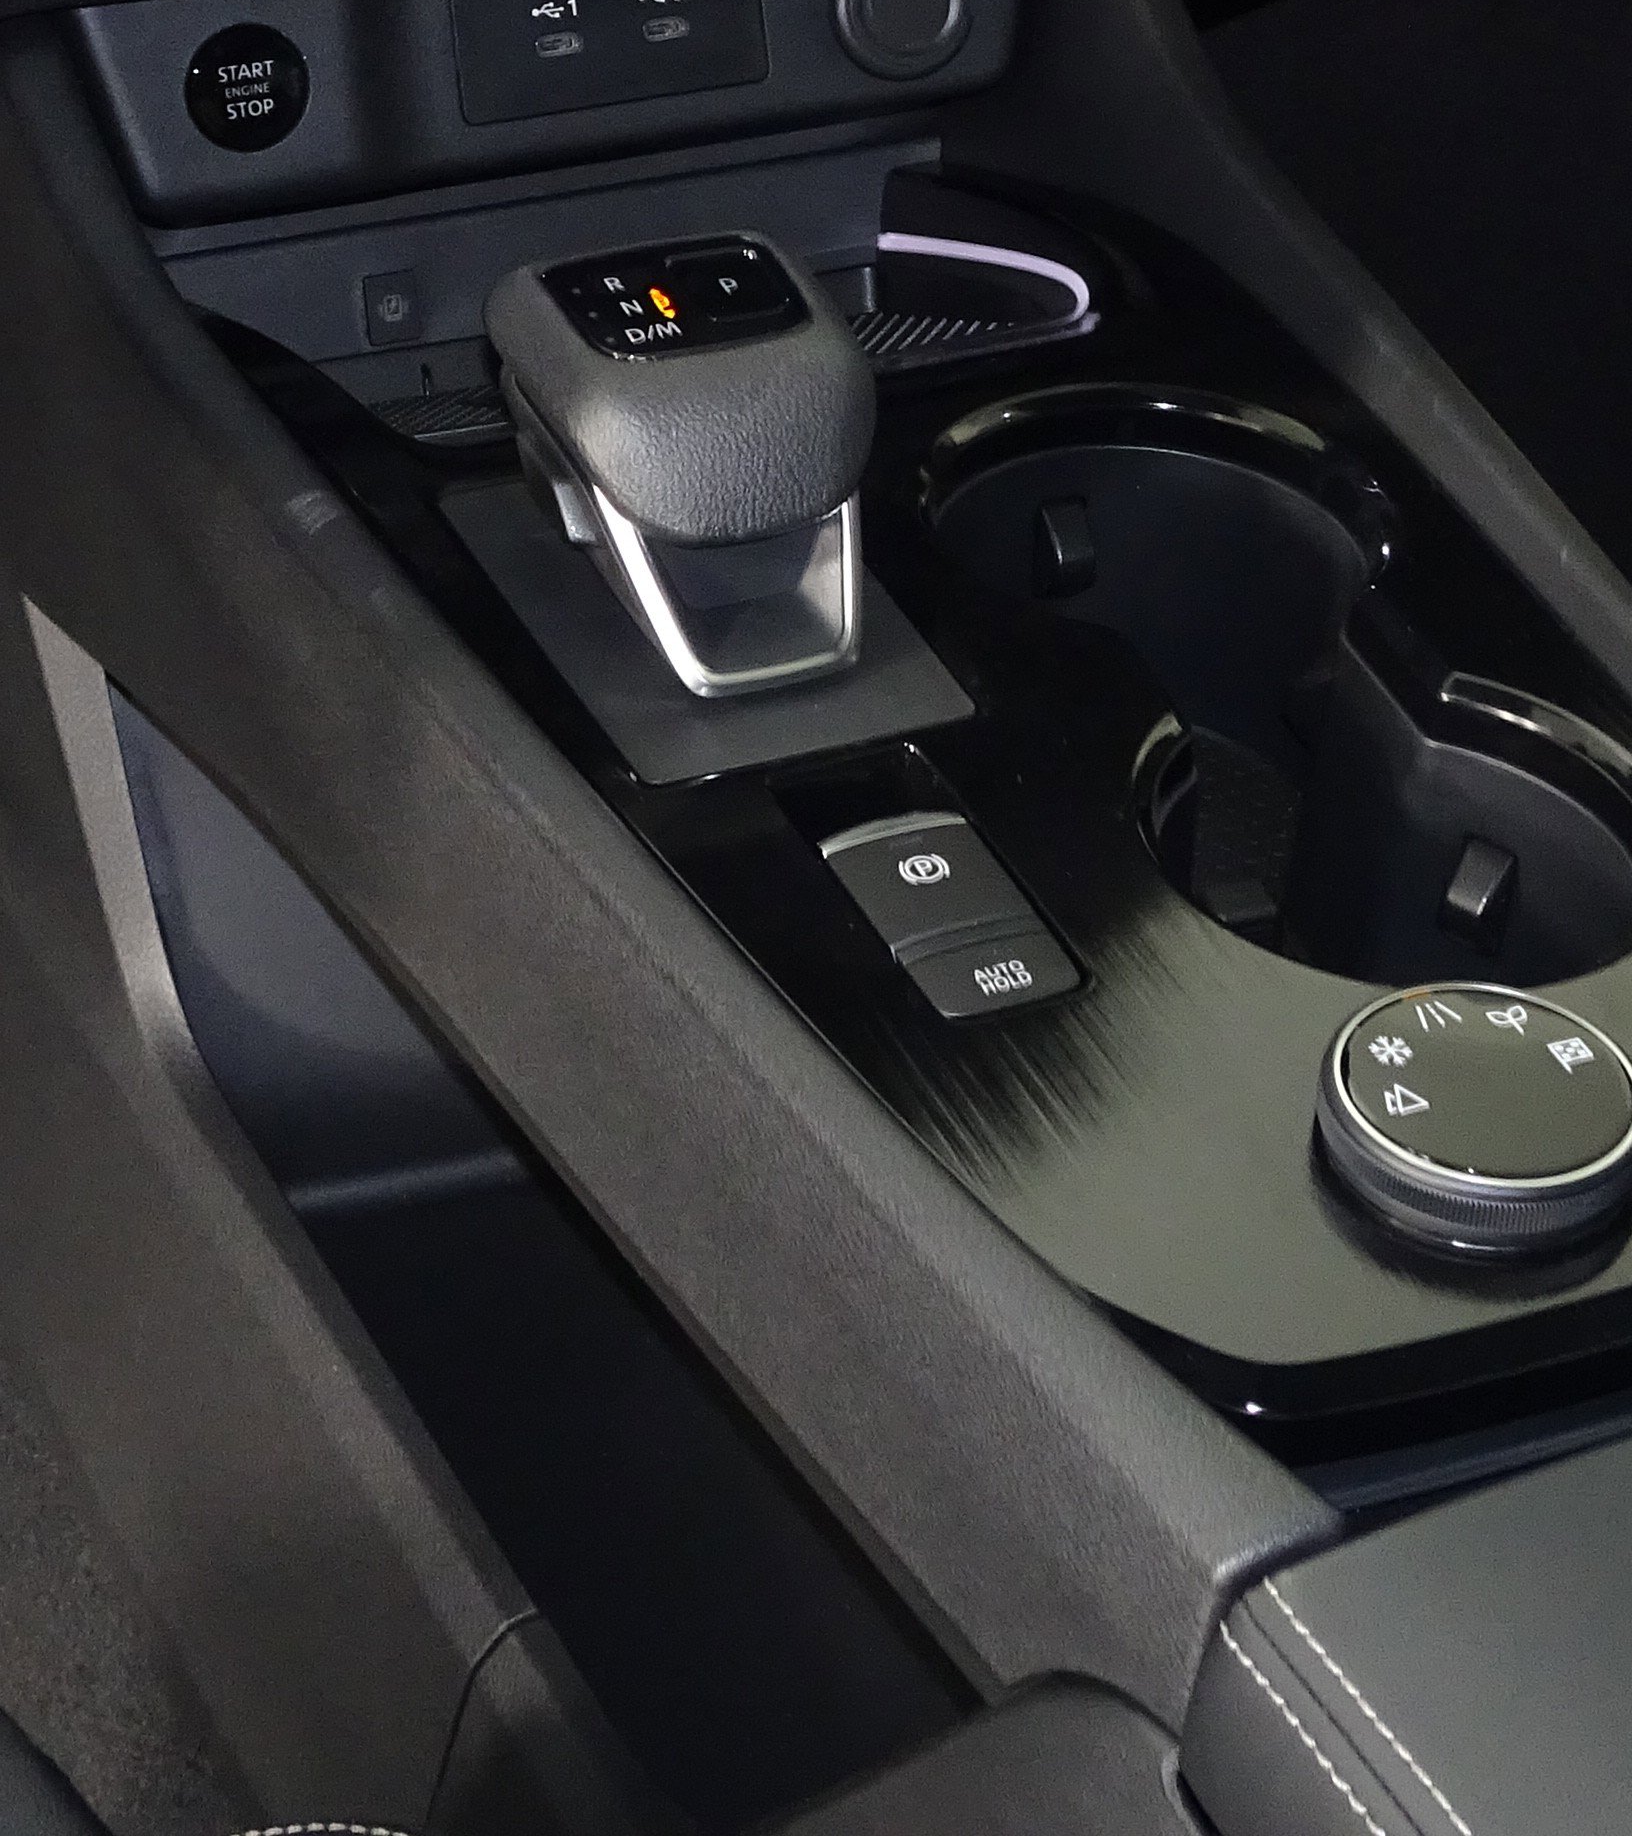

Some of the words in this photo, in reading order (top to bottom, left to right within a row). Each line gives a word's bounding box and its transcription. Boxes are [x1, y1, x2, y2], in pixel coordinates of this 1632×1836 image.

[217, 58, 275, 84] START
[224, 81, 271, 99] ENGINE
[225, 97, 275, 121] STOP
[603, 276, 626, 295] R
[718, 276, 739, 297] P
[619, 298, 645, 318] N
[624, 320, 684, 345] D/M
[974, 960, 1026, 985] AUTO
[980, 970, 1033, 996] HOLD
